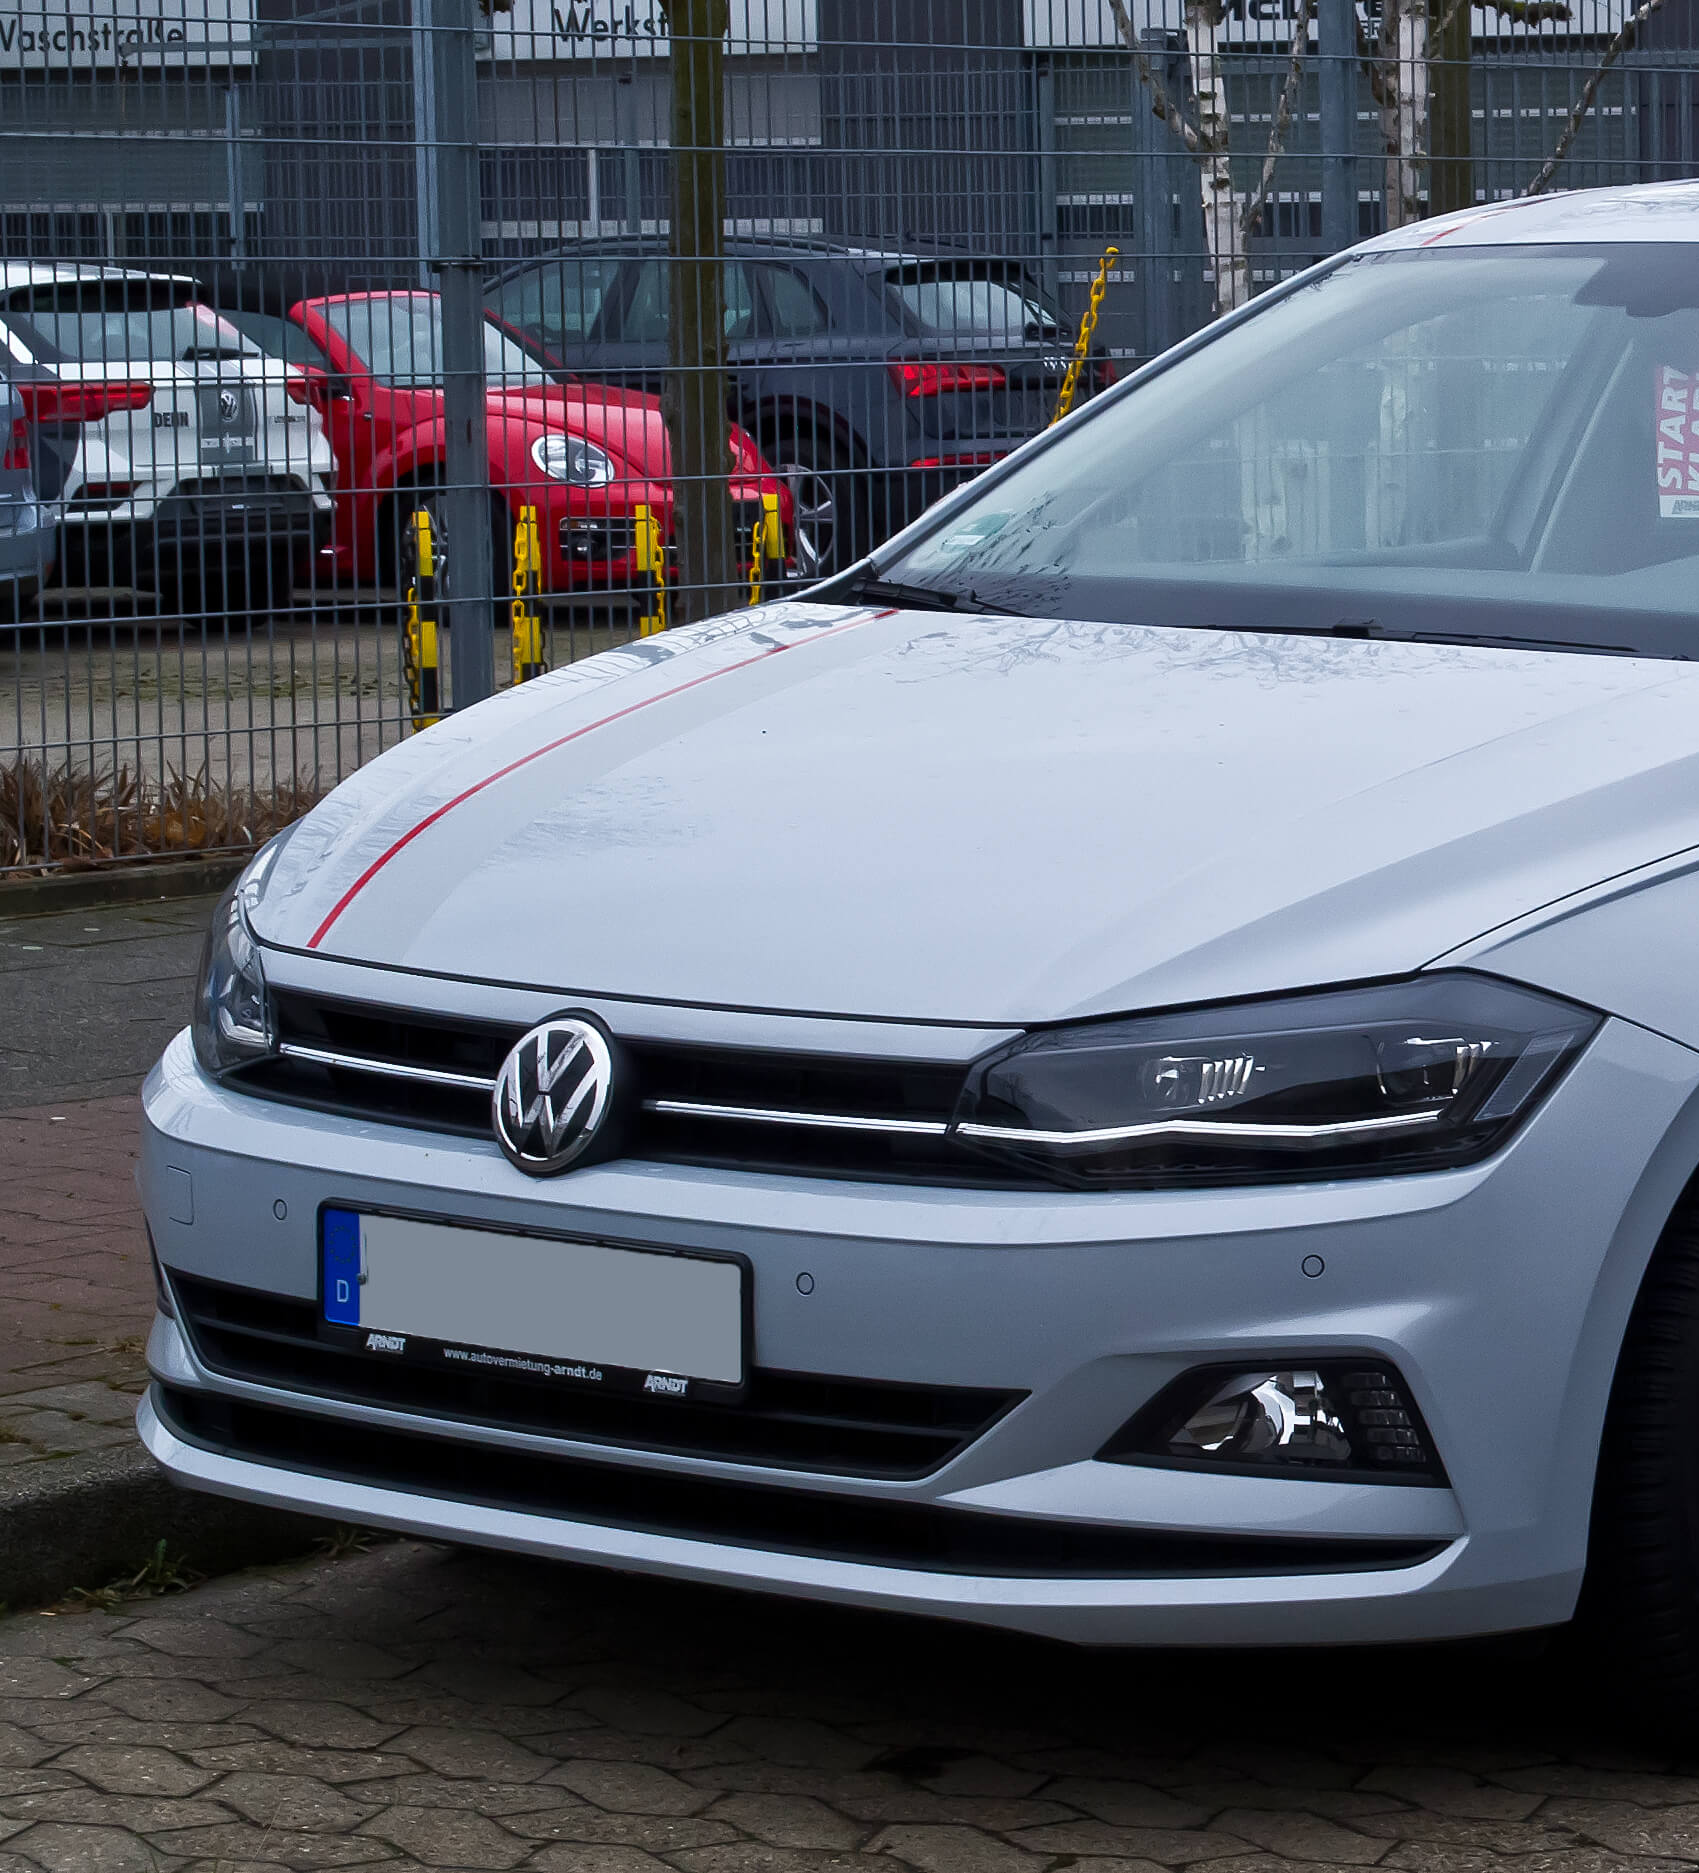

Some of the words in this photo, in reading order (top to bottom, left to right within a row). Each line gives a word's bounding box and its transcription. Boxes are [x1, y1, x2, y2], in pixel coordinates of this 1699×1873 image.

[553, 5, 669, 41] Werkst
[336, 1279, 350, 1303] D
[366, 1333, 406, 1351] ARNDT
[443, 1348, 603, 1381] www.autovermietung-arndt.de
[644, 1374, 689, 1393] ARNDT
